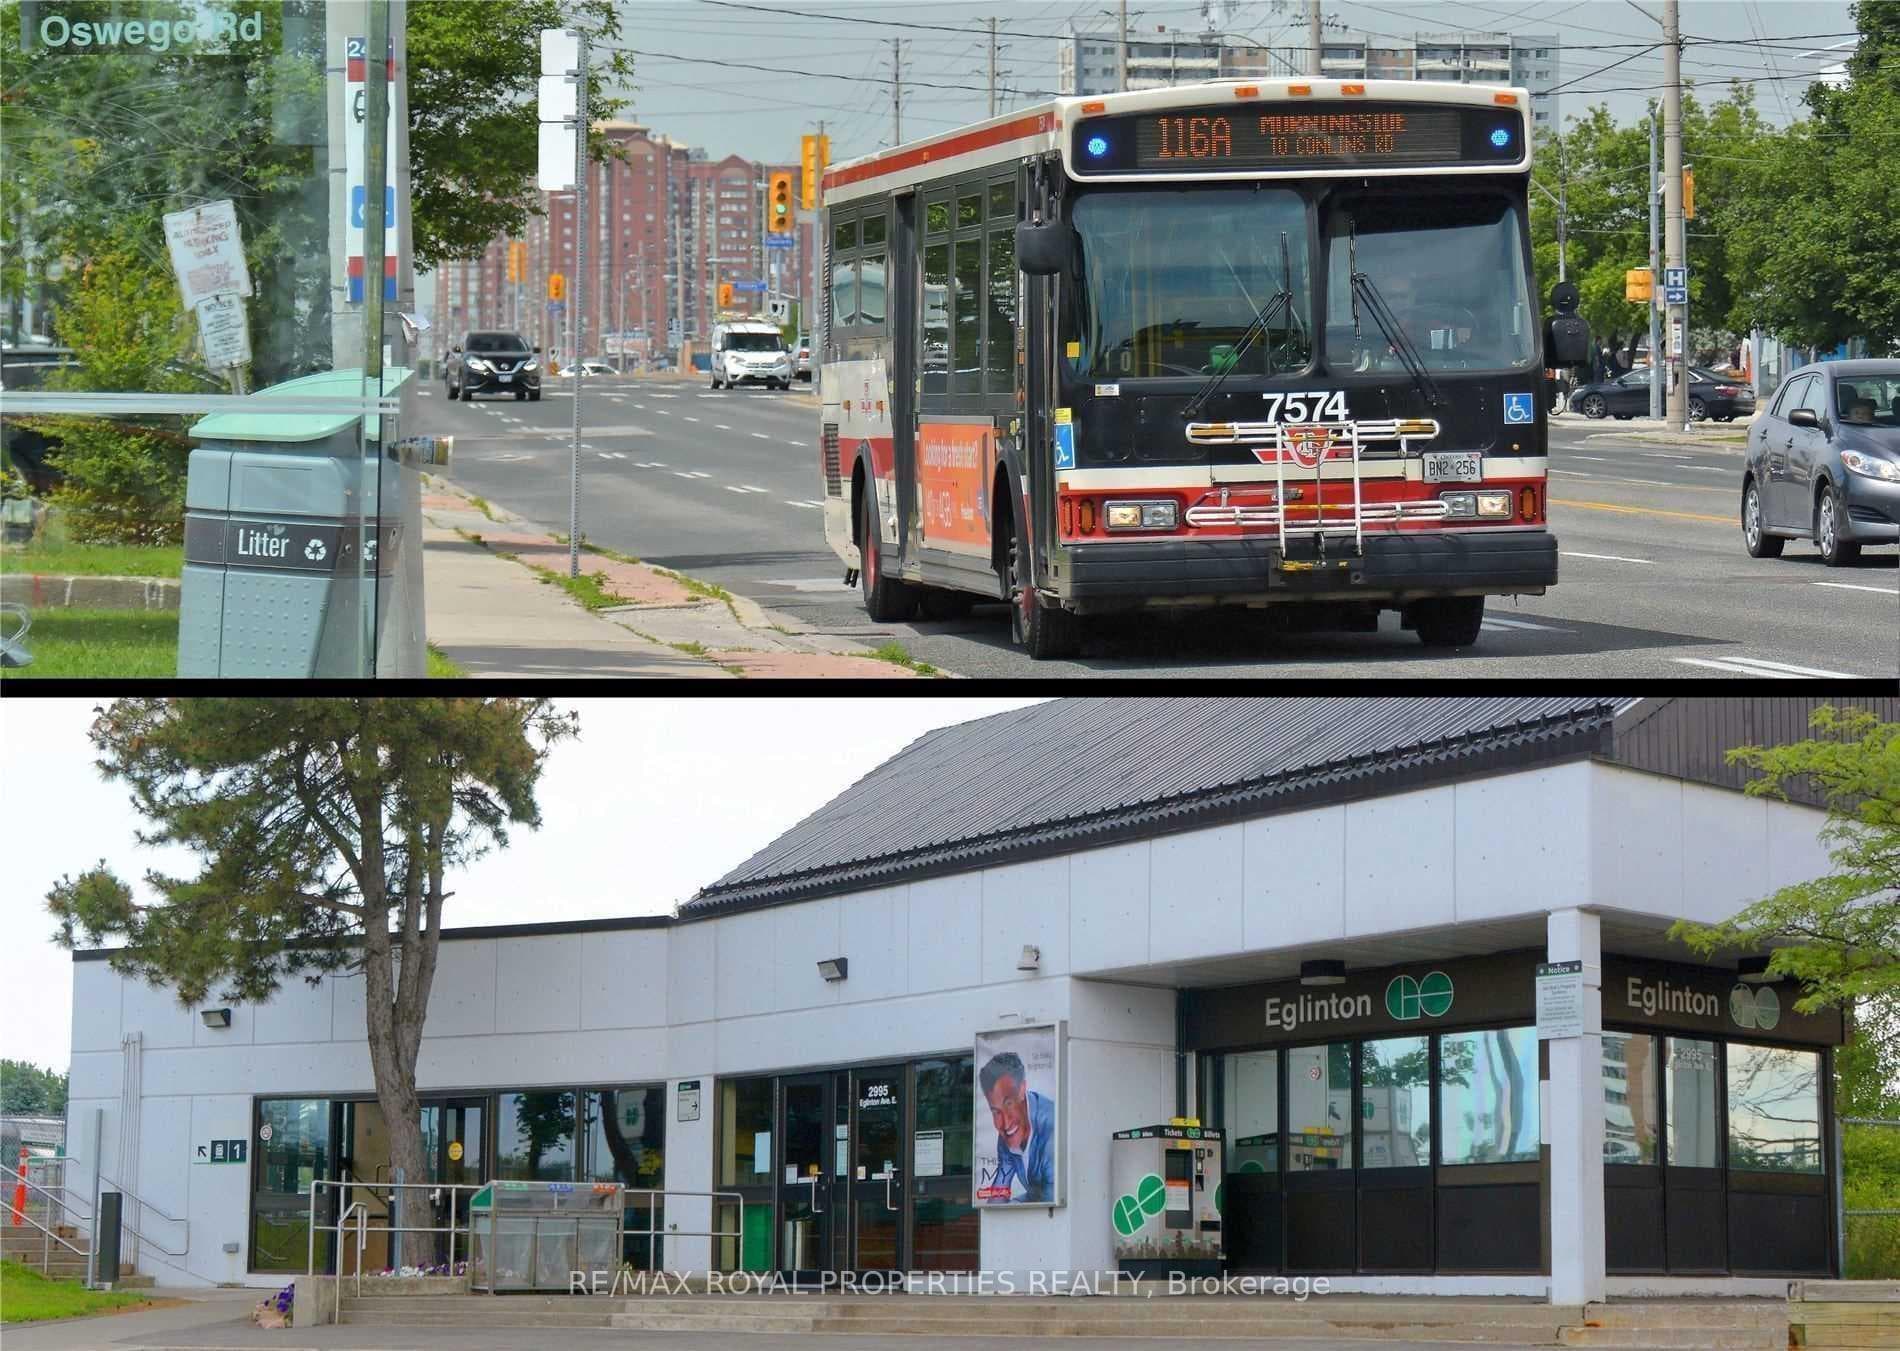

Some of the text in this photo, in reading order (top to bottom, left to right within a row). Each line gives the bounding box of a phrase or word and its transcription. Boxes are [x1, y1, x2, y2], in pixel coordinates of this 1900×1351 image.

[40, 11, 262, 51] Oswego Rd
[1157, 117, 1232, 160] 116A
[1271, 137, 1288, 156] TO
[1375, 133, 1394, 154] RD
[1668, 271, 1684, 286] H
[1262, 390, 1350, 424] 7574
[237, 528, 290, 558] Litter
[1265, 993, 1371, 1031] Eglinton
[1627, 977, 1719, 1017] Eglinton
[867, 1085, 889, 1097] 2995
[233, 1143, 241, 1159] 1
[981, 1167, 1014, 1185] MY
